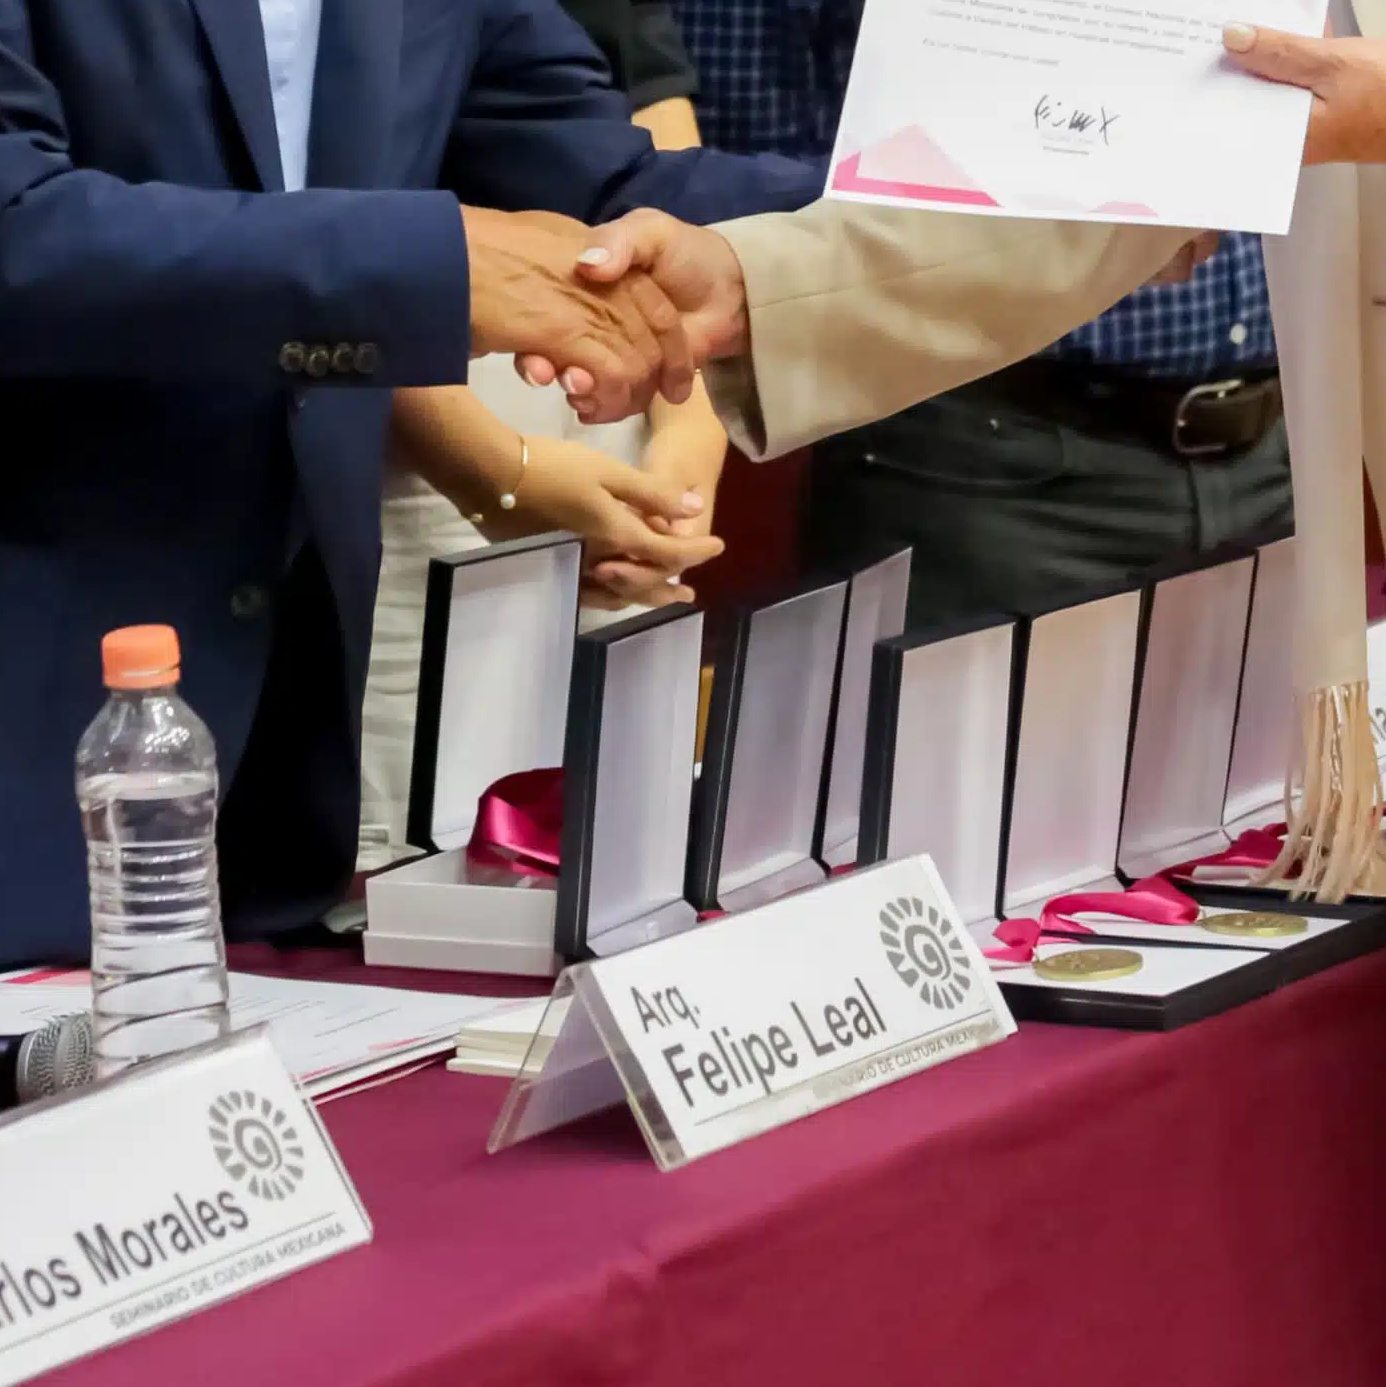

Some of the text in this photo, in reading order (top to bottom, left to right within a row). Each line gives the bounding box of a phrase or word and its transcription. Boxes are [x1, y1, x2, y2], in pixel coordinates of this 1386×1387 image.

[630, 981, 701, 1034] Arq.
[663, 1023, 799, 1107] Felipe
[791, 977, 887, 1056] Leal
[896, 1040, 946, 1068] CULTURA
[73, 1185, 250, 1288] Morales
[109, 1286, 190, 1330] SEMINARIO
[213, 1249, 277, 1287] CULTURA
[277, 1221, 346, 1258] MEXICANA
